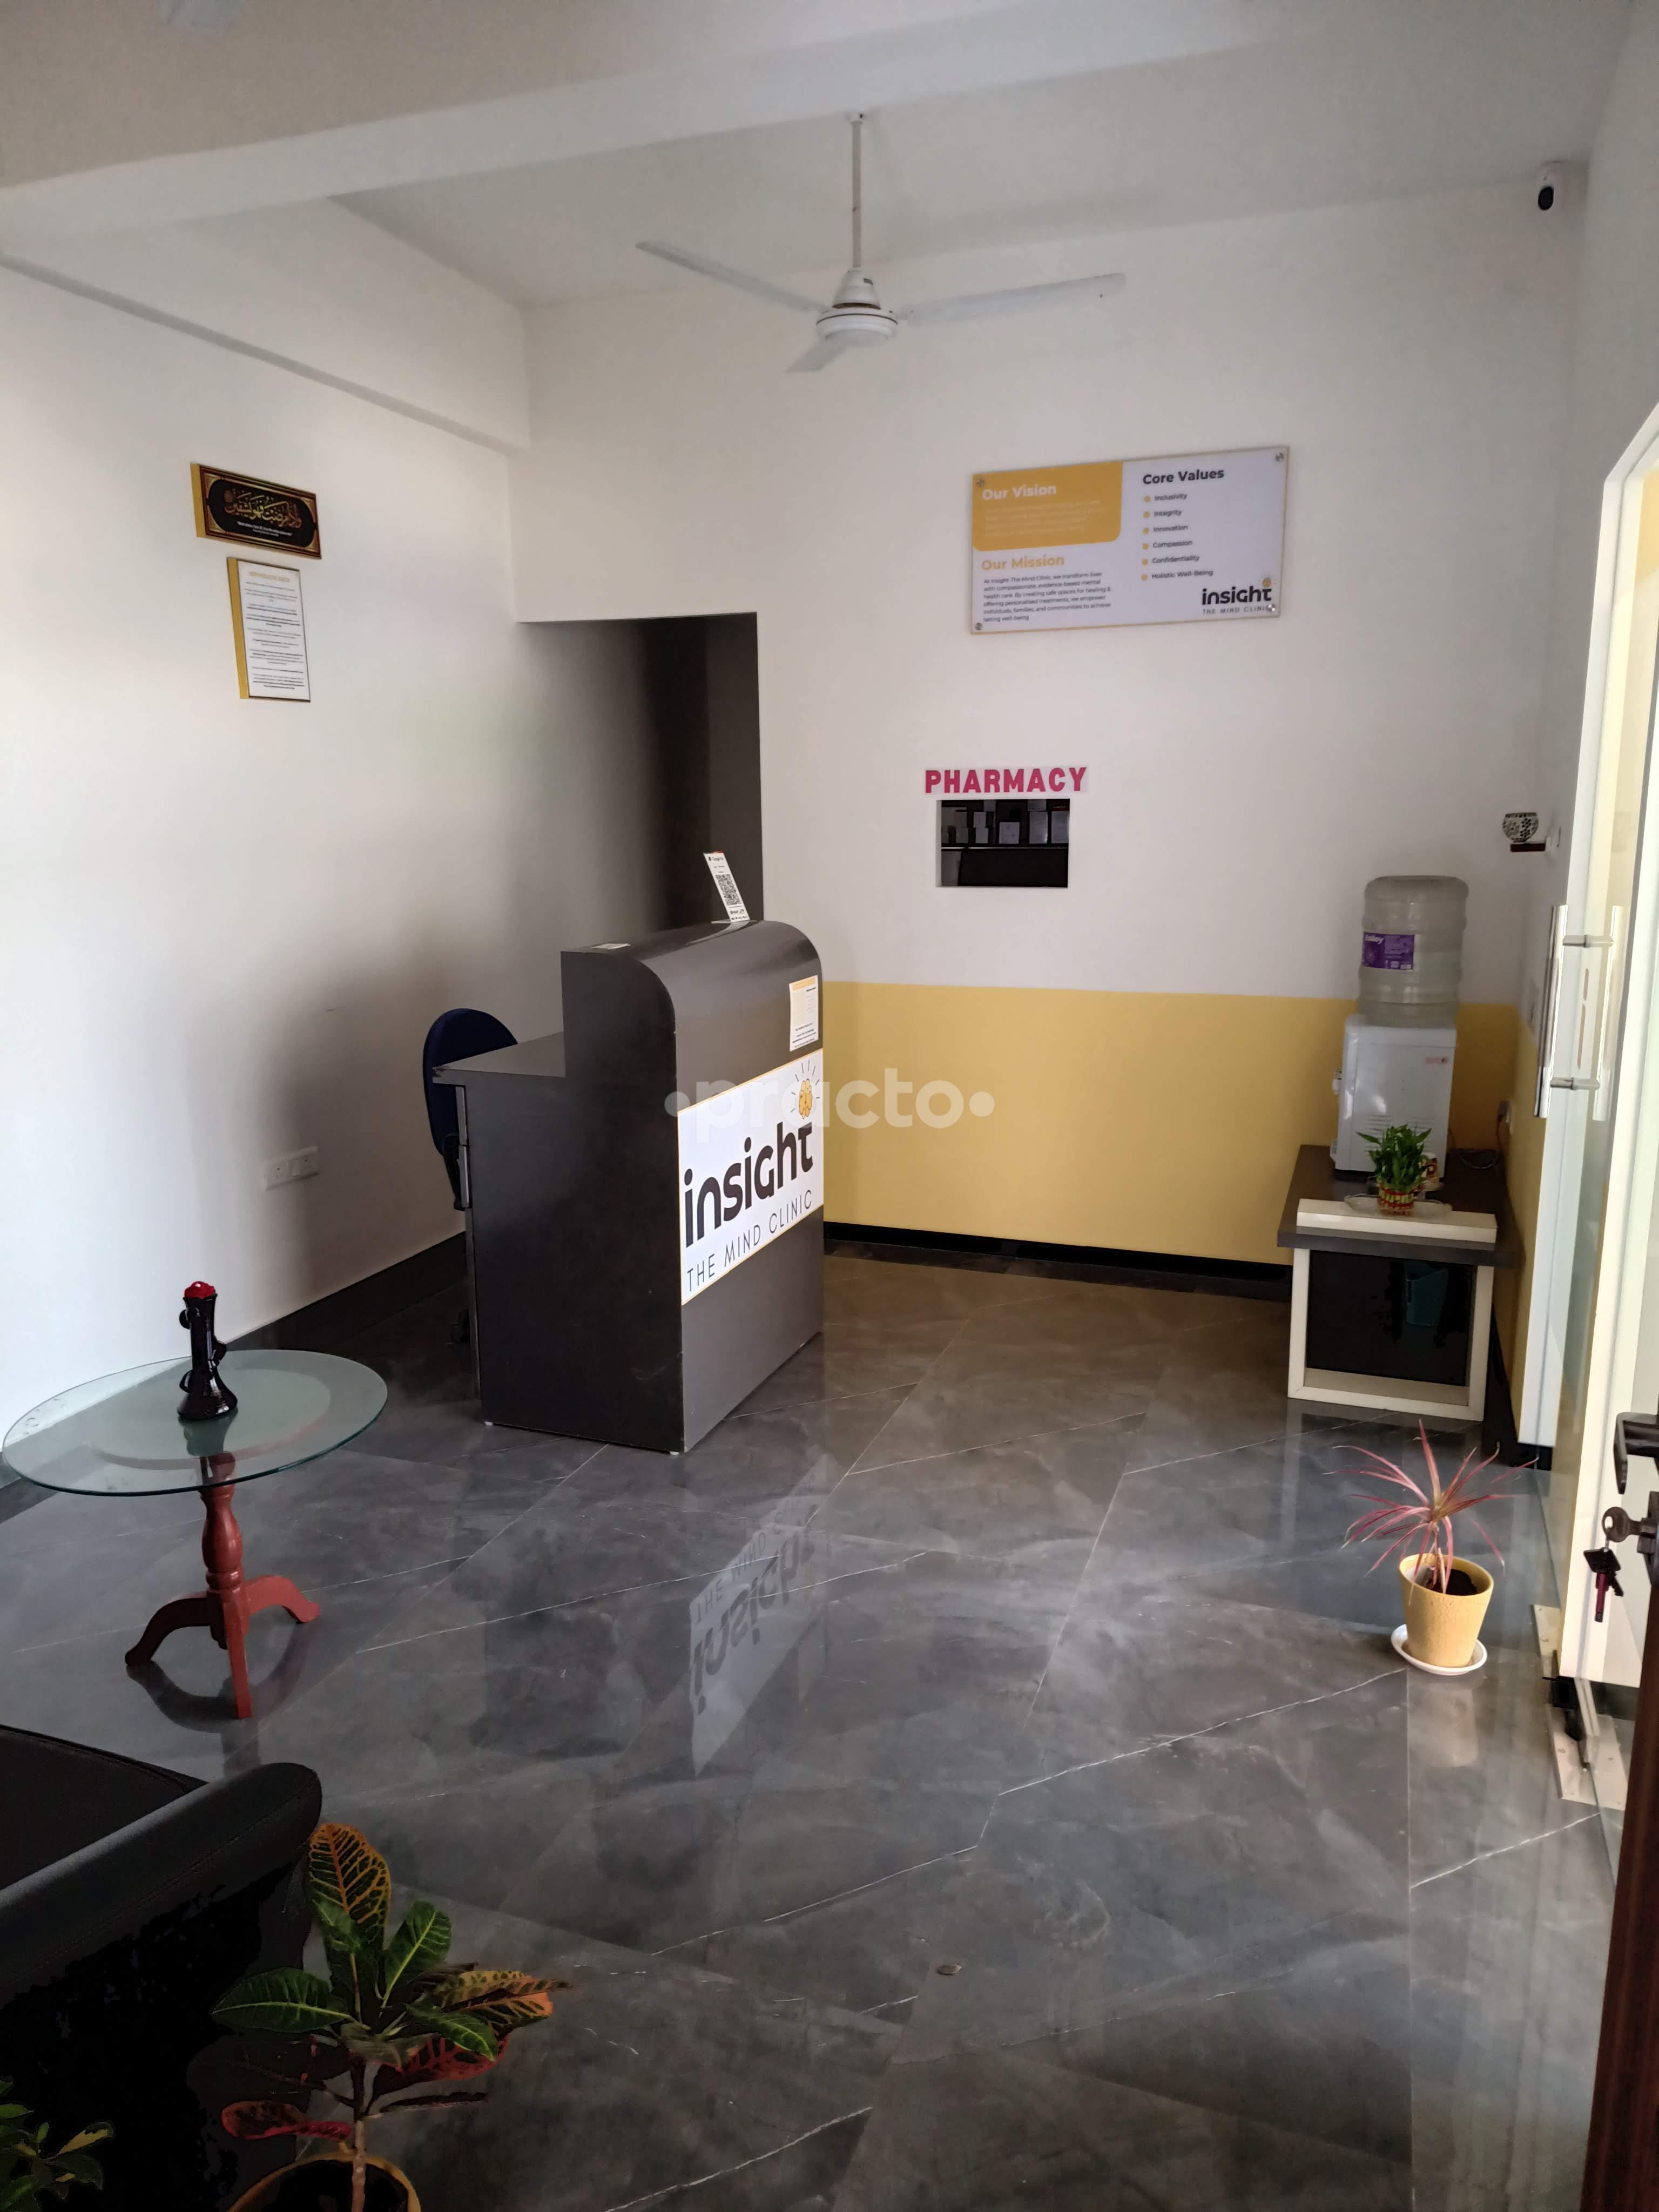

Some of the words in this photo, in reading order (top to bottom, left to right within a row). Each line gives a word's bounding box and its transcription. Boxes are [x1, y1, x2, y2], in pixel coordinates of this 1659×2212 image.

[1143, 474, 1174, 484] Core
[1178, 469, 1224, 482] Values
[982, 489, 1008, 500] Our
[1012, 484, 1057, 497] Vision
[1153, 524, 1188, 532] Innovation
[1152, 540, 1192, 549] Compassion
[982, 559, 1007, 570] Our
[1011, 554, 1064, 569] Mission
[1152, 555, 1199, 563] Confidentiality
[1202, 585, 1272, 605] insight
[925, 767, 1087, 793] PHARMACY
[684, 1121, 813, 1249] insight
[686, 1254, 716, 1292] THE
[724, 1225, 761, 1267] MIND
[769, 1190, 812, 1235] CLINIC
